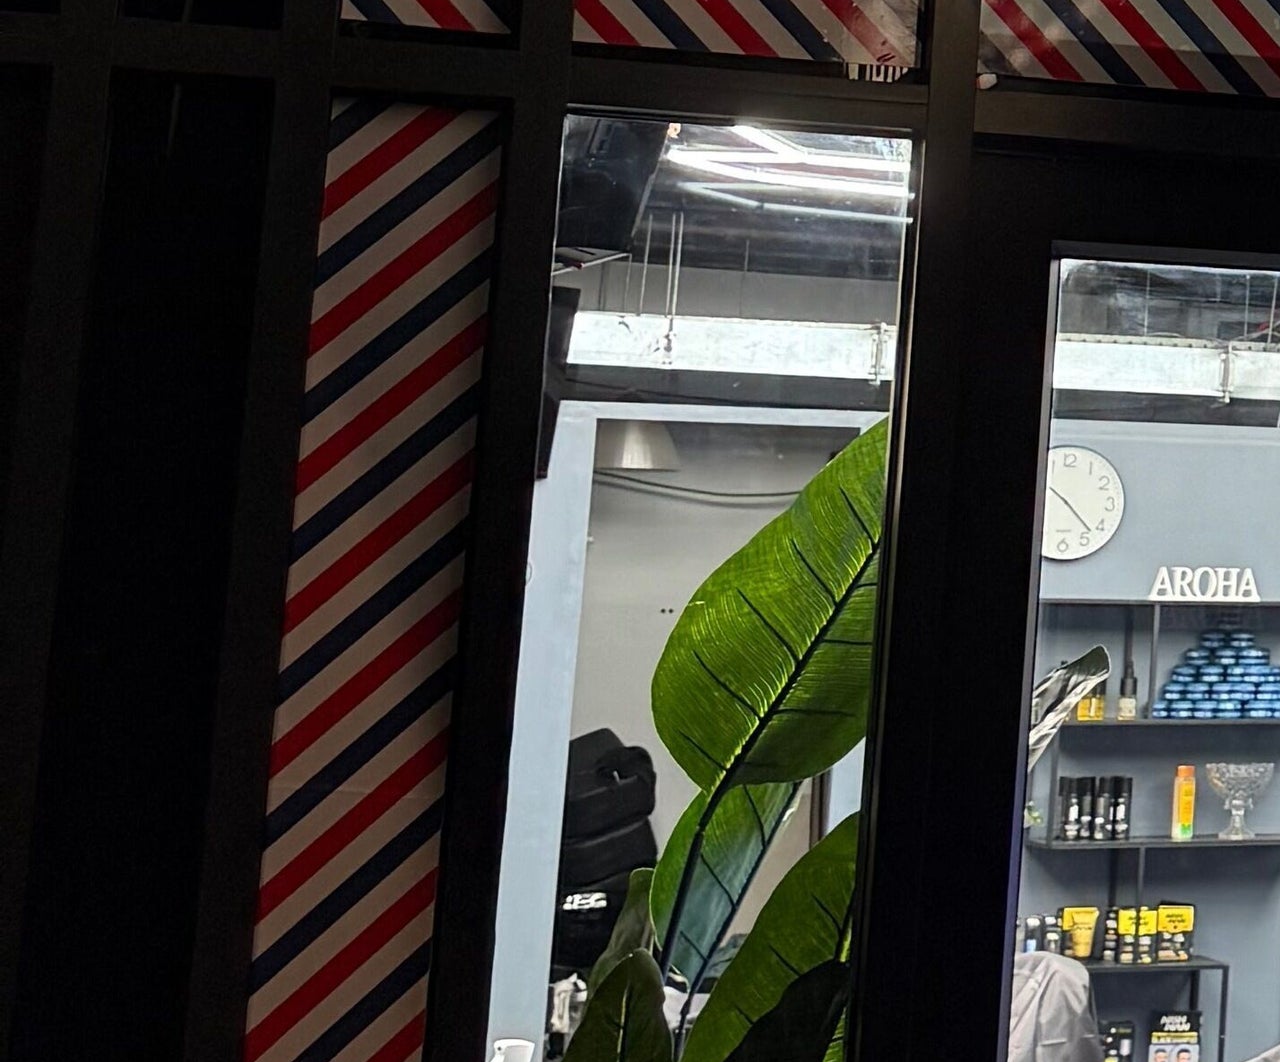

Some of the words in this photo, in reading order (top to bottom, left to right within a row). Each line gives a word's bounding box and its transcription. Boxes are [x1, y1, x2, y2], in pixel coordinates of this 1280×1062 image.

[1063, 453, 1077, 468] 12
[1088, 460, 1094, 476] 1
[1098, 475, 1112, 491] 2
[1104, 496, 1115, 512] 3
[1095, 518, 1106, 532] 4
[1056, 537, 1069, 554] 6
[1079, 531, 1090, 547] 5
[1148, 566, 1261, 602] AROHA
